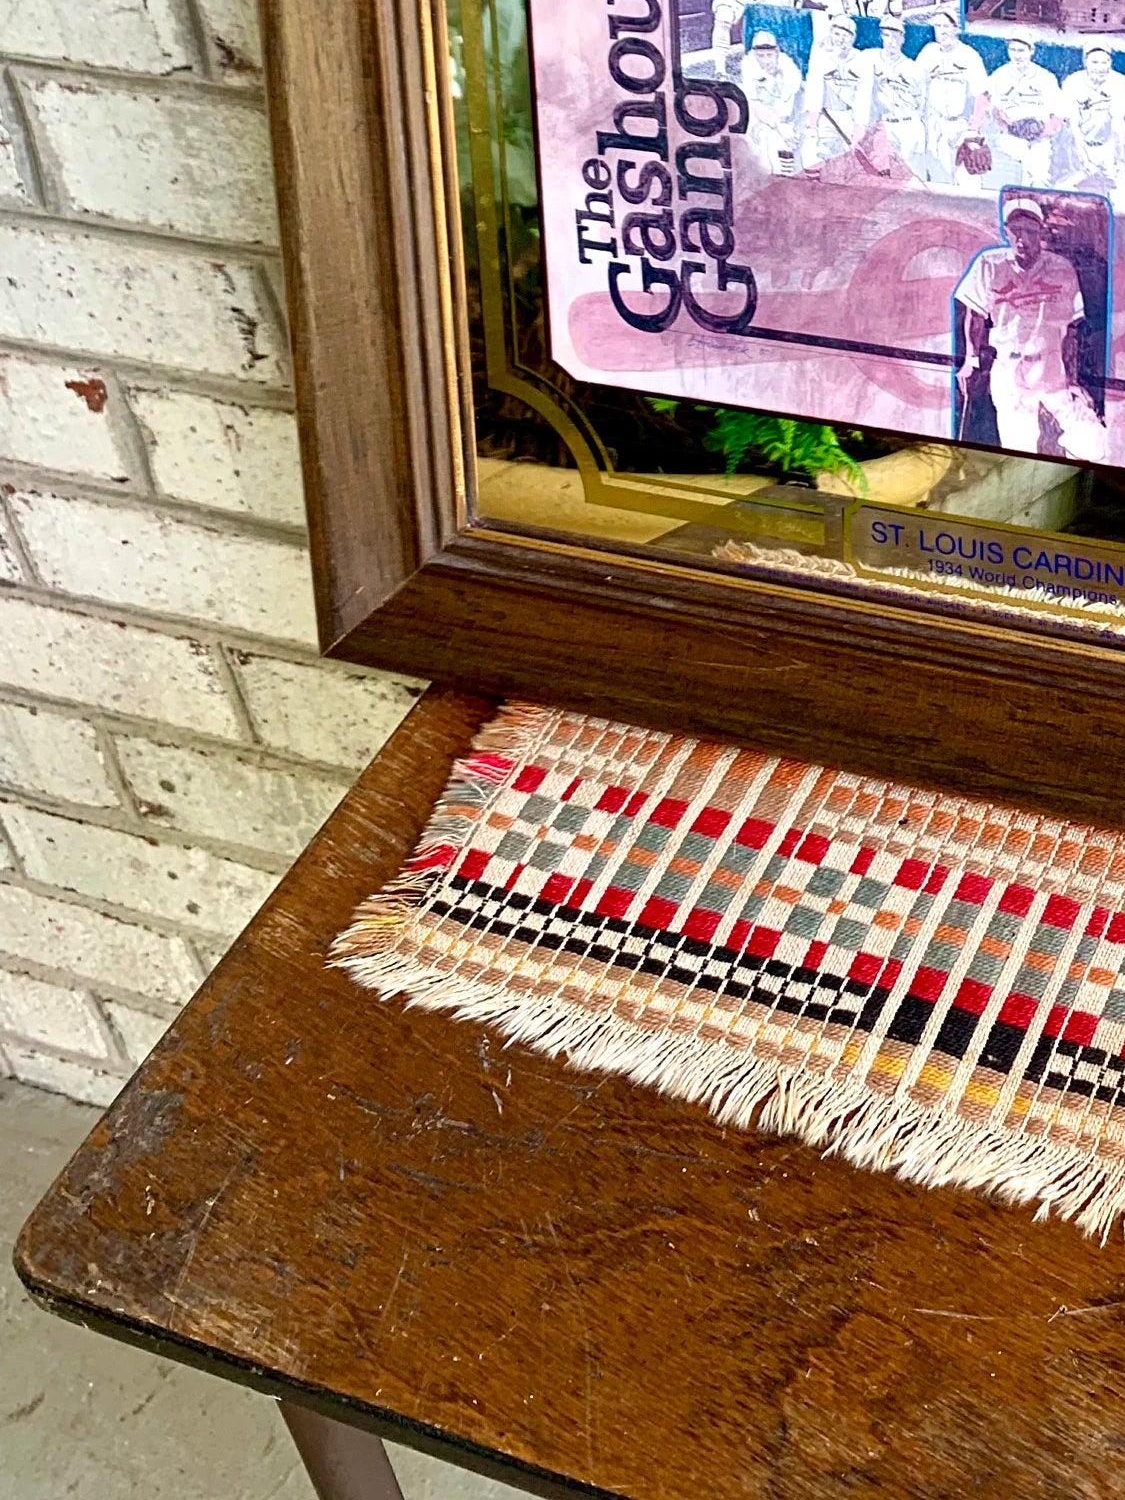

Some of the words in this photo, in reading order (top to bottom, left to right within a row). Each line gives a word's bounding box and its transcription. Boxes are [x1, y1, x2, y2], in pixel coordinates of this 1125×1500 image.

[576, 157, 615, 266] The
[674, 76, 758, 333] Gang
[871, 521, 910, 549] ST.
[919, 530, 1004, 565] LOUIS
[928, 558, 963, 577] 1934
[969, 566, 1016, 587] World
[1022, 575, 1117, 606] Champions
